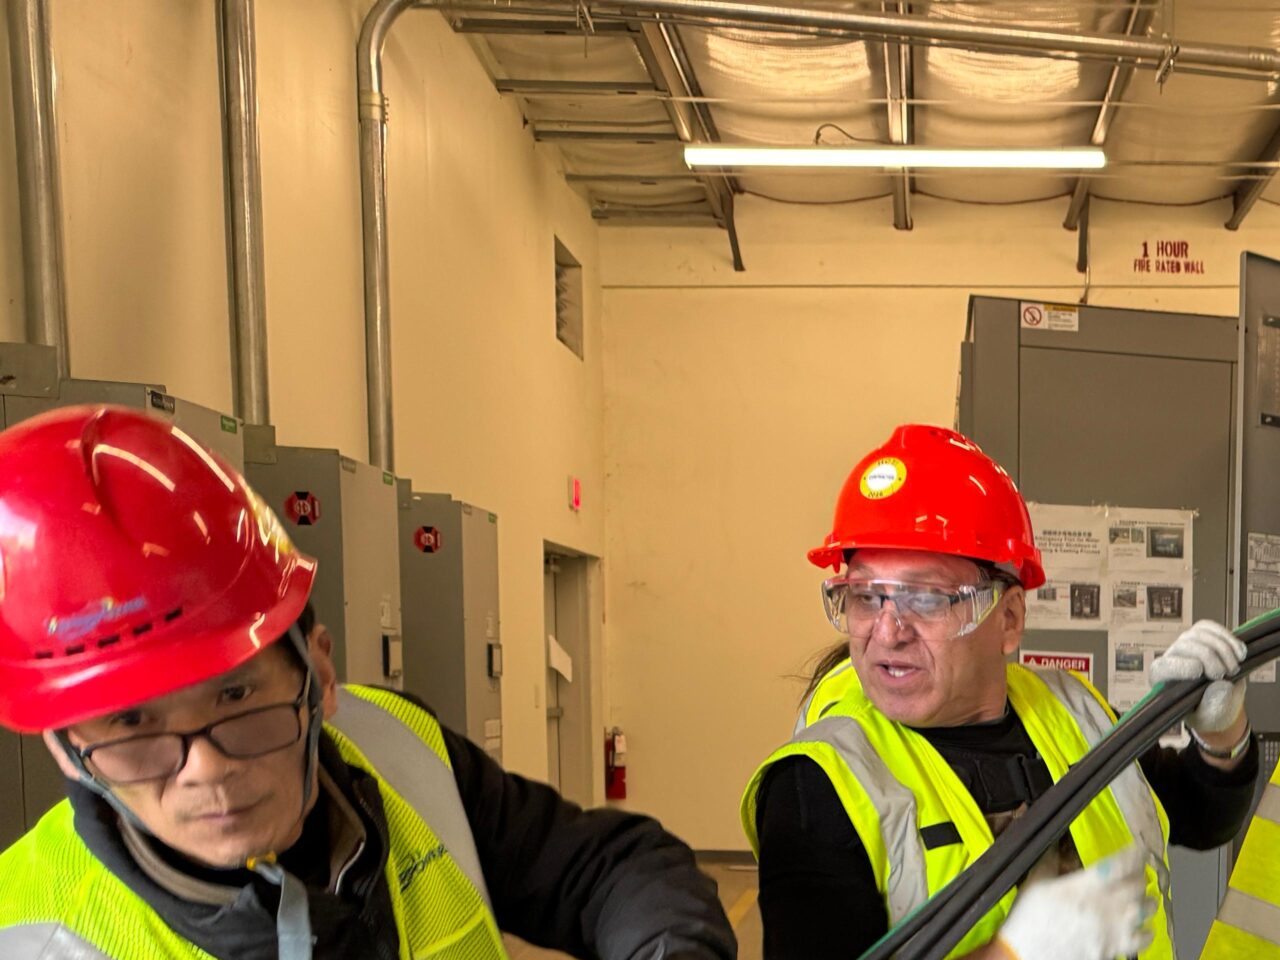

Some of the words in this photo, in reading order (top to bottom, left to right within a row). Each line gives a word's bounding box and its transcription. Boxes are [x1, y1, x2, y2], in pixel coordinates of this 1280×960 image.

[1142, 241, 1149, 258] 1
[1156, 240, 1189, 258] HOUR
[1134, 259, 1150, 272] FIRE
[1155, 260, 1181, 273] RATED
[1184, 261, 1204, 274] WALL
[1041, 657, 1086, 670] DANGER
